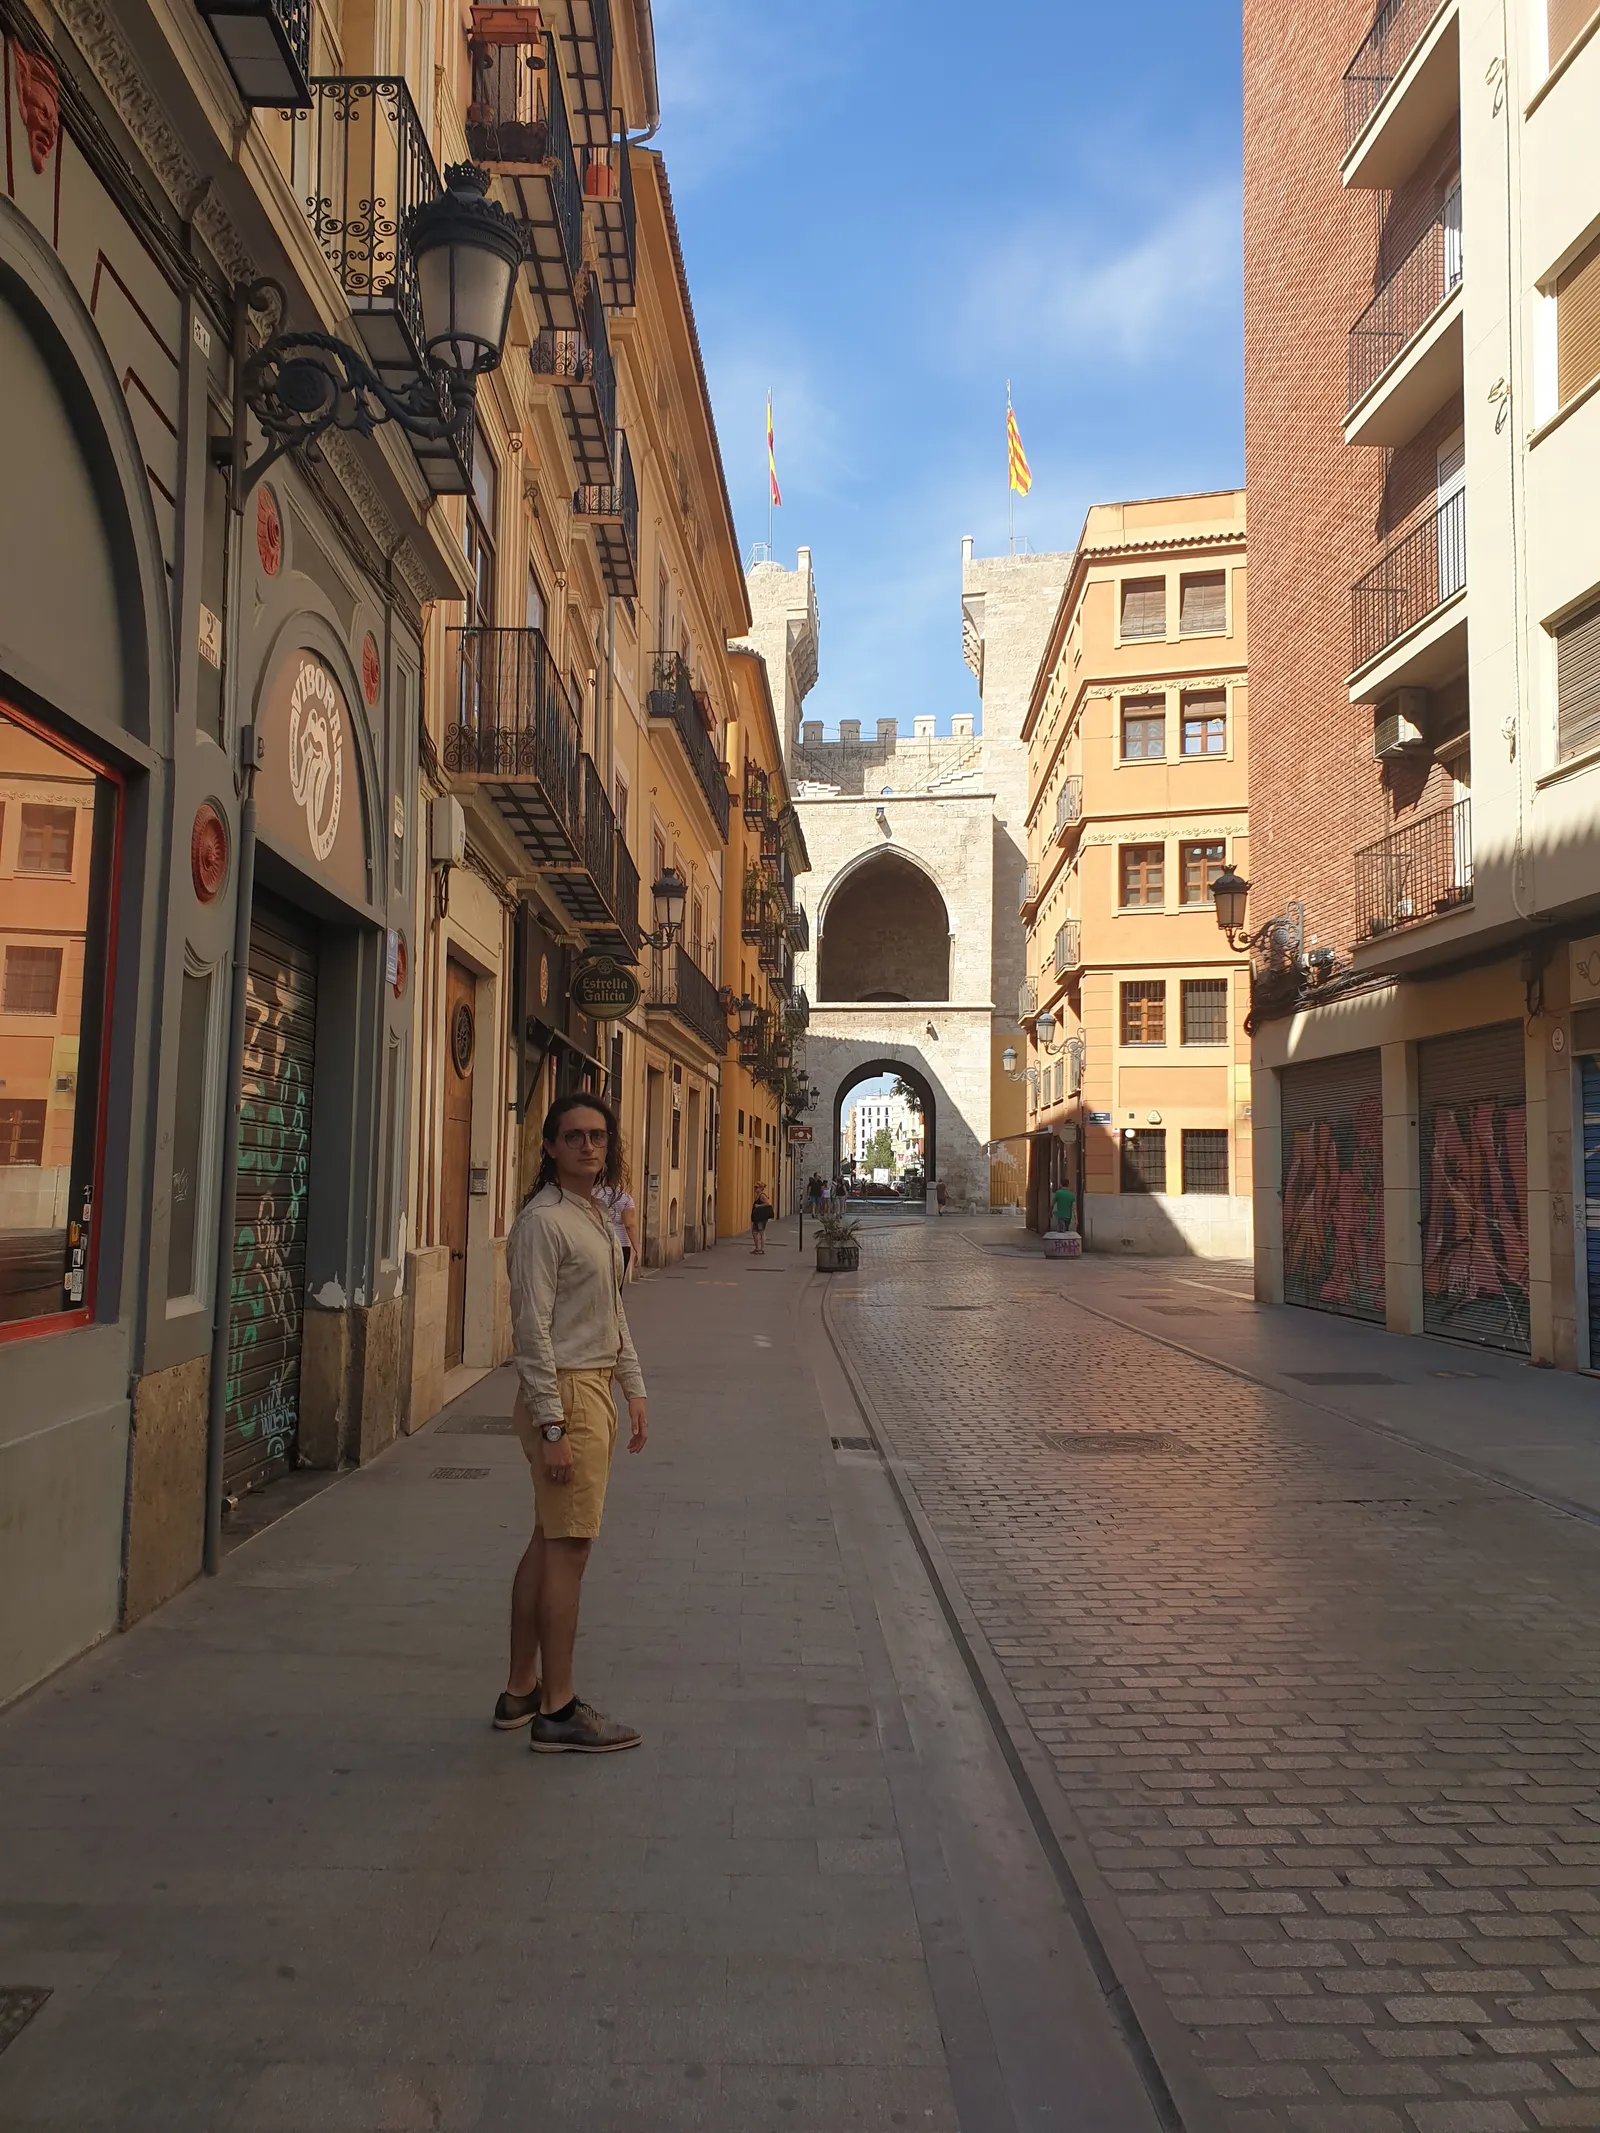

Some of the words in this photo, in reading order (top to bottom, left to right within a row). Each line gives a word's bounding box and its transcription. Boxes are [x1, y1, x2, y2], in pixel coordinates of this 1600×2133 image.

[290, 660, 343, 753] VÍBORA!
[582, 977, 628, 990] Estrella
[583, 989, 626, 1002] Galicia
